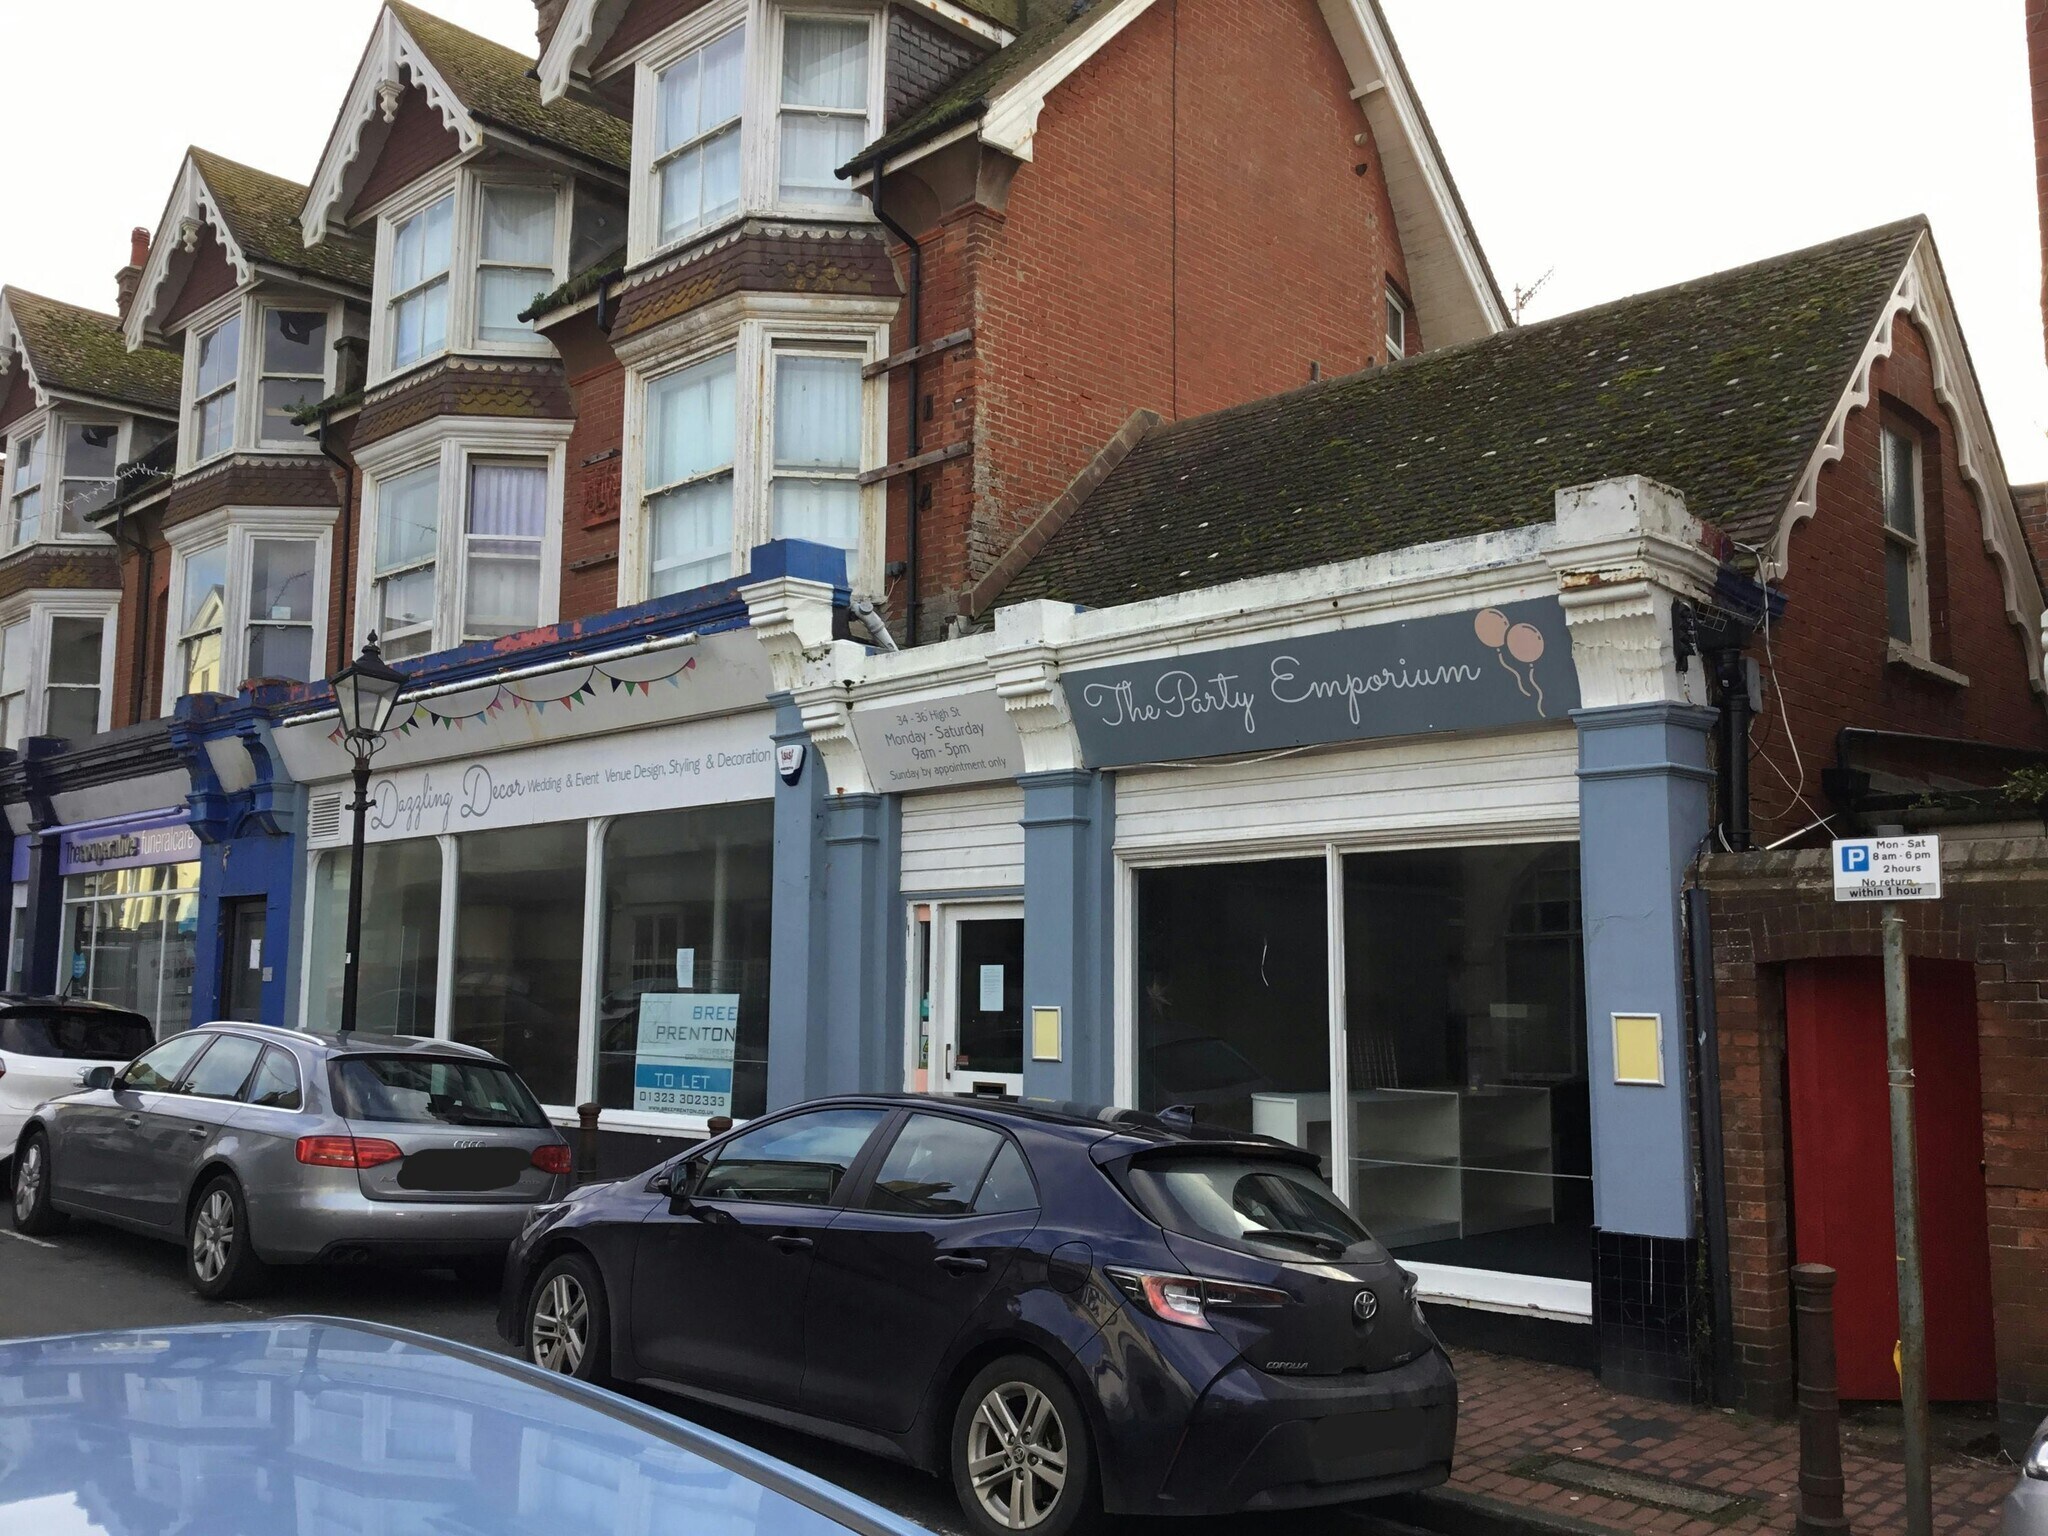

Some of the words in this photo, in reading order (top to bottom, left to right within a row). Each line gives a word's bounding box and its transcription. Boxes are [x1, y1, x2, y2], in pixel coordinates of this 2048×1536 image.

[1083, 681, 1160, 727] The
[1154, 670, 1254, 734] Party
[1270, 655, 1482, 725] Emporium
[896, 714, 908, 726] 34
[916, 711, 928, 723] 36
[929, 708, 949, 723] High
[950, 706, 961, 718] St
[885, 728, 926, 747] Monday
[935, 721, 984, 740] Saturday
[911, 746, 936, 760] 9am
[944, 742, 971, 759] 5pm
[889, 767, 920, 781] Sunday
[921, 766, 932, 778] by
[934, 759, 986, 776] appointment
[987, 756, 1007, 769] only
[370, 773, 453, 832] Dazzling
[460, 764, 526, 818] Decor
[527, 776, 562, 794] Wedding
[566, 773, 574, 788] &
[575, 771, 599, 787] Event
[605, 766, 631, 783] Venue
[633, 762, 667, 781] Design,
[669, 757, 701, 777] Styling
[705, 754, 715, 769] &
[717, 748, 771, 768] Decoration
[1876, 840, 1899, 849] Mon
[1907, 839, 1926, 848] Sat
[1872, 852, 1879, 861] 8
[1881, 852, 1897, 860] am
[1905, 851, 1912, 860] 6
[1914, 851, 1931, 861] pm
[1861, 877, 1877, 887] No
[1879, 877, 1913, 887] return
[1849, 888, 1884, 898] within
[1887, 887, 1893, 896] 1
[1896, 885, 1922, 896] hour
[693, 1006, 738, 1021] BREE
[656, 1025, 736, 1042] PRENTON
[654, 1072, 674, 1087] TO
[681, 1074, 710, 1090] LET
[640, 1091, 675, 1104] 01323
[679, 1094, 725, 1107] 302333
[1265, 1361, 1309, 1370] COROLLA
